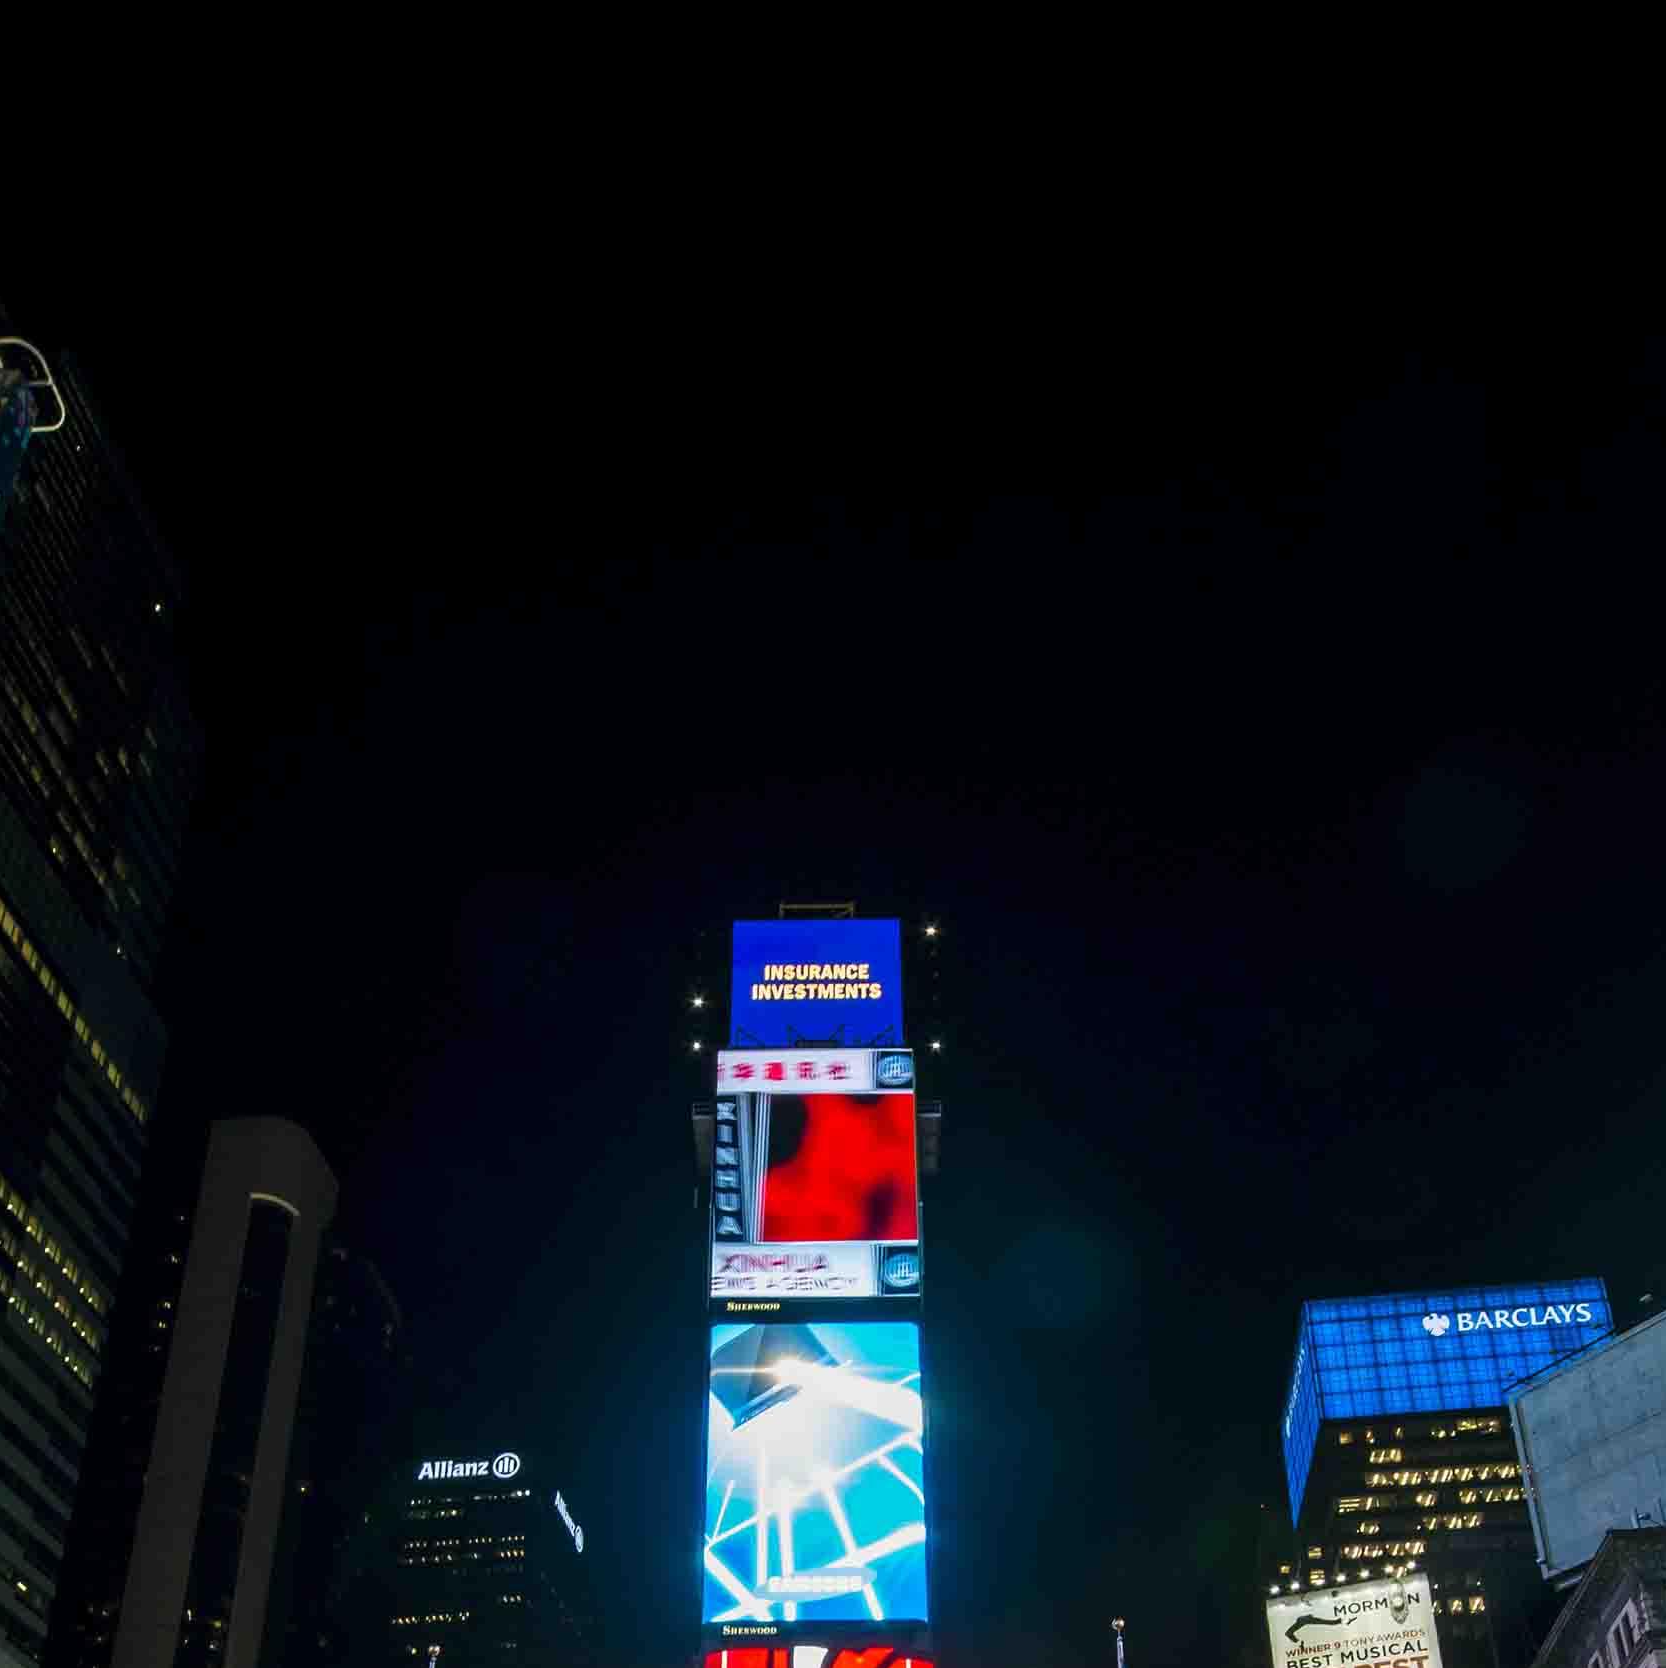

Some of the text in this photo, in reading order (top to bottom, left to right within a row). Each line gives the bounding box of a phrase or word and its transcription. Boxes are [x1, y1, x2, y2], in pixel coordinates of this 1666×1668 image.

[764, 963, 870, 981] INSURANCE
[751, 983, 881, 1001] INVESTMENTS
[727, 1301, 781, 1312] SHERWOOD
[1458, 1303, 1592, 1331] BARCLAYS
[418, 1460, 490, 1480] Allianz
[723, 1625, 777, 1636] SHERWOOD
[1345, 1635, 1375, 1649] TONY
[1341, 1640, 1428, 1664] MUSICAL
